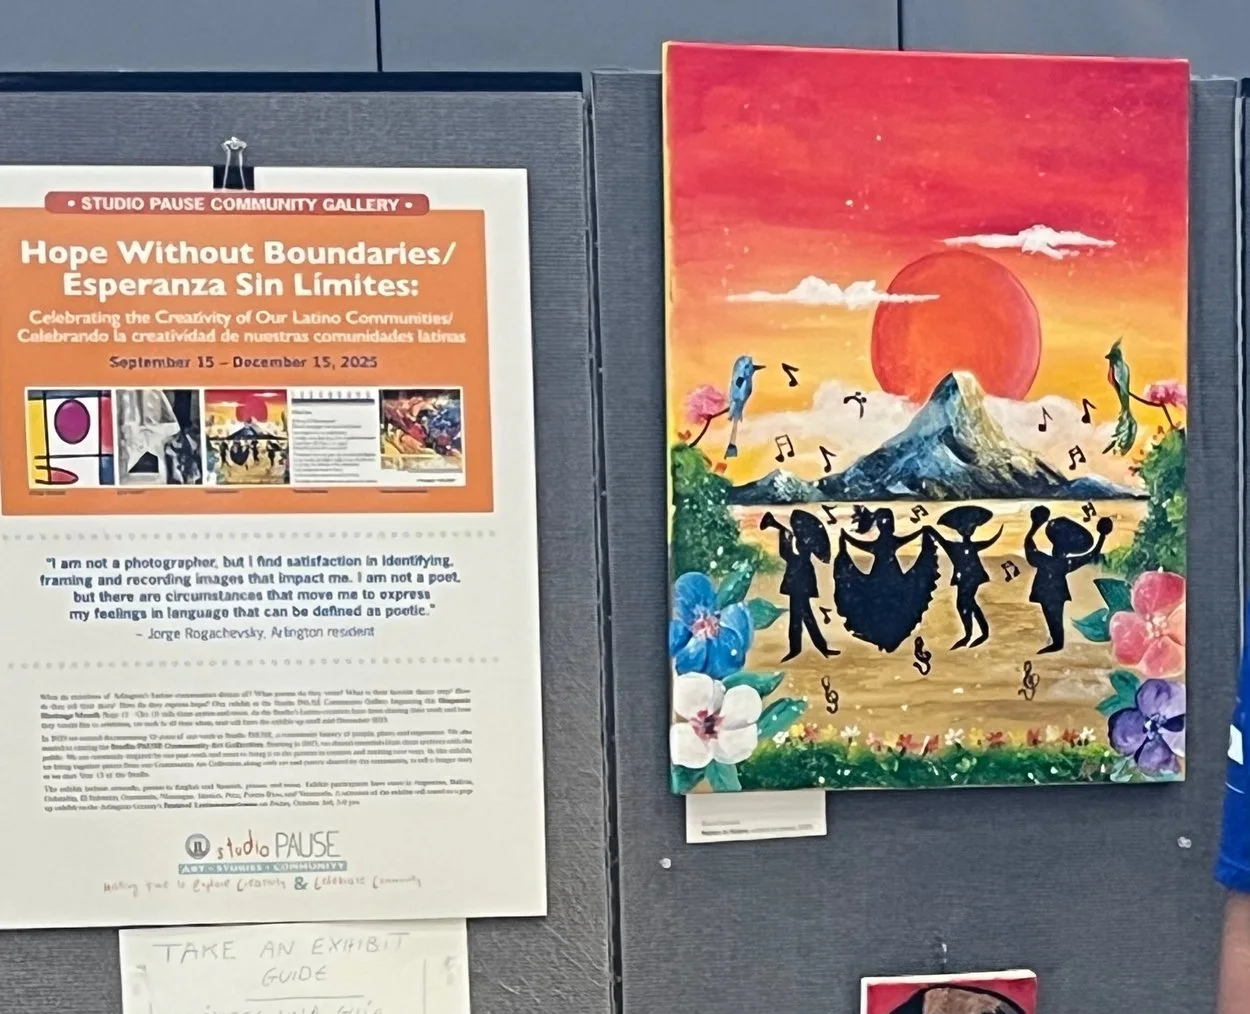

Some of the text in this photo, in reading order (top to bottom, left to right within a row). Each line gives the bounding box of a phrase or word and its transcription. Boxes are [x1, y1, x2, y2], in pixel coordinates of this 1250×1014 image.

[81, 197, 399, 212] STUDIO PAUSE COMMUNITY GALLERY
[21, 241, 456, 269] Hope Without Boundaries/
[63, 272, 418, 301] Esperanza Sin Límites:
[30, 311, 454, 328] Celebrating the Creativity of Our Latino Communities/
[18, 329, 466, 343] Celebrando la creatividad de nuestras comunidades latinas
[110, 356, 191, 372] September
[198, 356, 214, 368] 15
[234, 356, 307, 368] December
[314, 357, 335, 370] 15,
[341, 357, 377, 368] 2025
[60, 560, 81, 569] am
[86, 559, 108, 569] not
[113, 560, 120, 569] a
[223, 555, 243, 567] but
[257, 555, 281, 567] find
[287, 555, 362, 567] satisfaction
[41, 574, 92, 590] framing
[98, 574, 122, 586] and
[127, 574, 191, 590] recording
[197, 574, 244, 589] images
[249, 573, 275, 585] that
[279, 572, 324, 588] impact
[366, 574, 386, 584] am
[392, 573, 413, 584] not
[417, 574, 424, 584] a
[74, 589, 431, 603] but there are circumstances that move me to express
[70, 609, 90, 622] my
[95, 606, 146, 622] feelings
[151, 607, 163, 618] in
[168, 606, 229, 622] language
[233, 606, 259, 618] that
[264, 608, 288, 618] can
[292, 606, 308, 617] be
[313, 605, 362, 617] defined
[367, 607, 381, 617] as
[148, 628, 181, 641] Jorge
[272, 626, 323, 639] Arlington
[327, 625, 375, 637] resident
[218, 830, 340, 859] studio PAUSE
[152, 932, 409, 964] TAKE AN EXHIBIT
[262, 965, 328, 987] GUIDE
